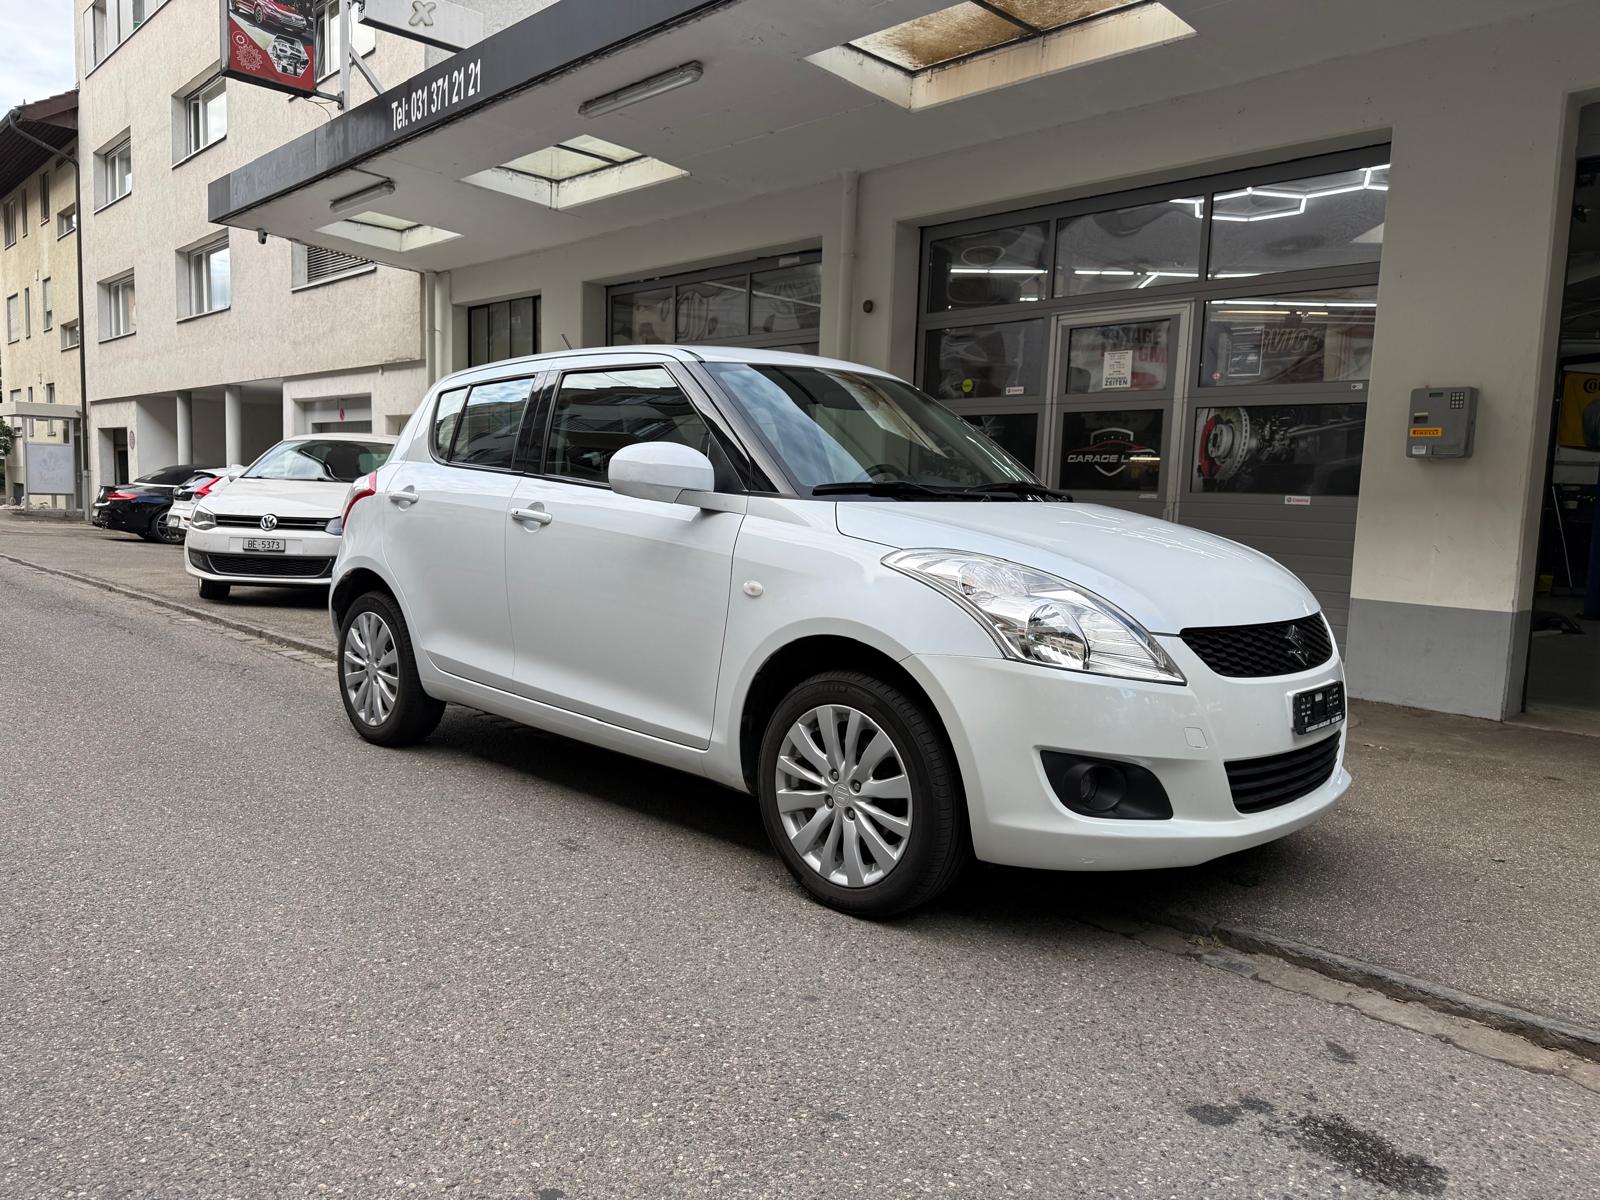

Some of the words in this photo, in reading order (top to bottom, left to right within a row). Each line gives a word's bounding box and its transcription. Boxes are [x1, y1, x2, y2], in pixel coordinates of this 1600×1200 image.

[391, 97, 408, 131] Tel:
[411, 86, 427, 122] 031
[431, 74, 448, 113] 371
[452, 66, 464, 104] 21
[468, 58, 480, 96] 21
[1105, 379, 1128, 387] ZEITEN
[1067, 455, 1119, 463] GARAGE
